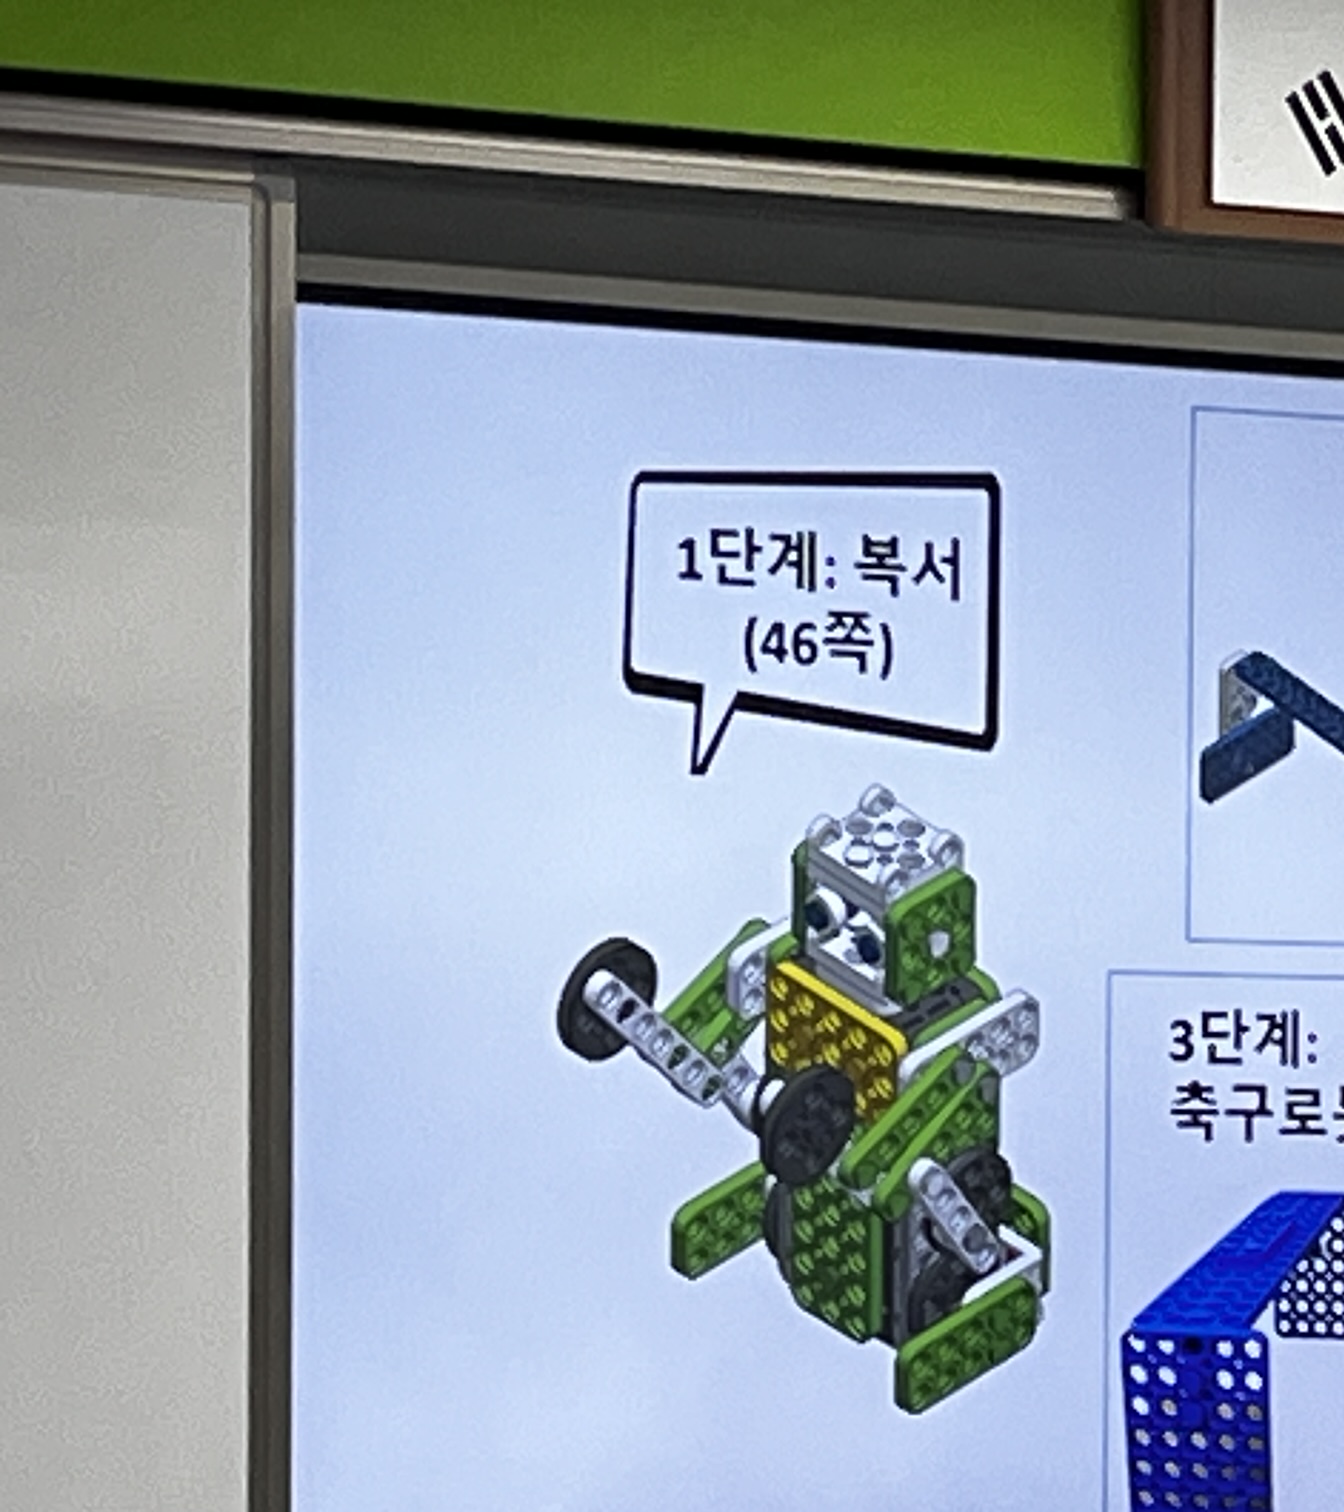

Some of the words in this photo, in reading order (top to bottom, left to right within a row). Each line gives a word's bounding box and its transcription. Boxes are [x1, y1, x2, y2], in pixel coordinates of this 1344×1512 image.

[678, 526, 836, 593] 1단계:
[853, 533, 961, 602] 복서
[744, 610, 893, 681] (46쪽)
[1169, 1008, 1318, 1070] 3단계:
